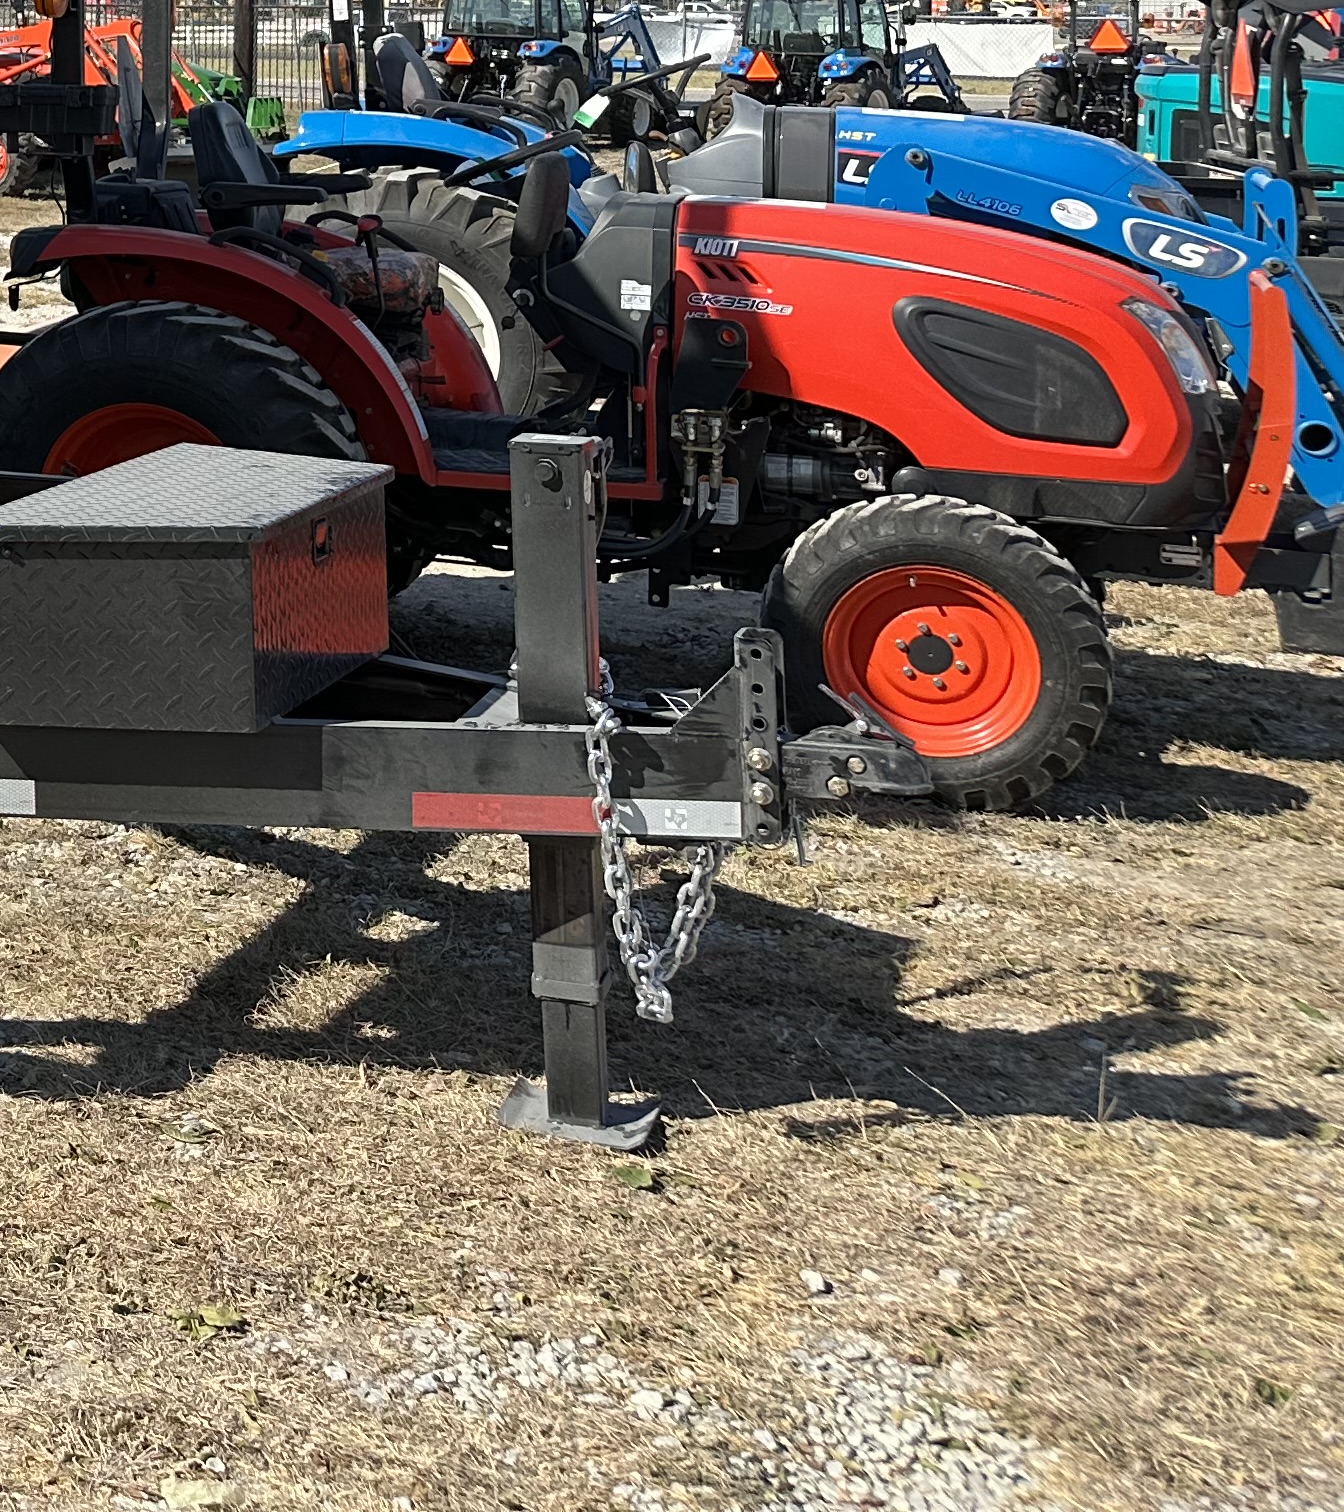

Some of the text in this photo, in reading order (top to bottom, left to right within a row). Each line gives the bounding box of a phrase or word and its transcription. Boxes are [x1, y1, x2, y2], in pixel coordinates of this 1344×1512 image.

[838, 130, 876, 142] HST
[841, 158, 875, 185] L
[955, 190, 1023, 216] LL4106
[694, 237, 740, 257] KIOTI
[1148, 233, 1210, 269] LS
